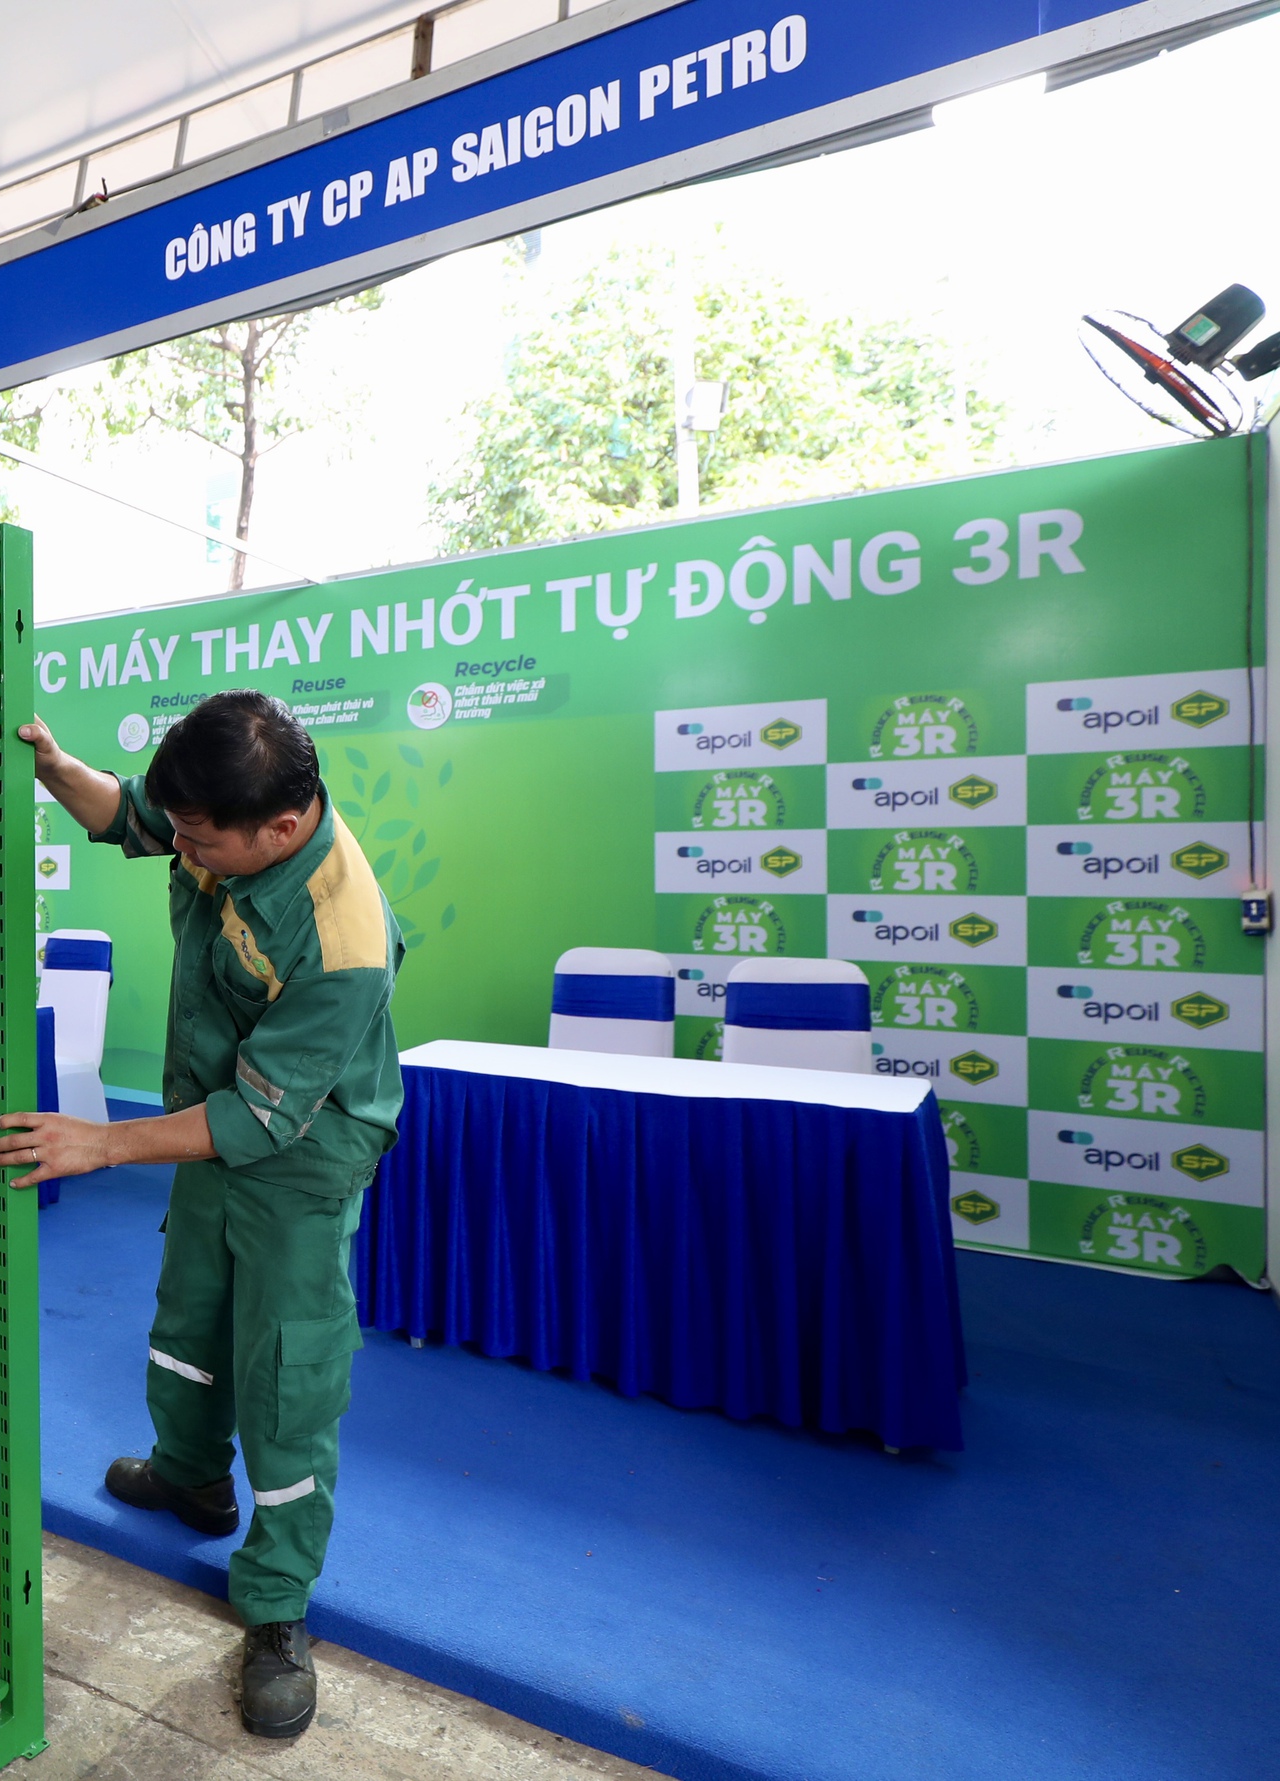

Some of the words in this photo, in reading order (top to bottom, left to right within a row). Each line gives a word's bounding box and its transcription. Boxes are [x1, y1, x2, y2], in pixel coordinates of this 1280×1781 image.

[165, 212, 256, 280] CÔNG
[267, 190, 311, 245] TY
[322, 170, 373, 227] CP
[383, 147, 438, 208] AP
[452, 79, 620, 183] SAIGON
[639, 14, 807, 121] PETRO
[80, 629, 180, 690] MÁY
[191, 613, 334, 675] THAY
[350, 579, 531, 658] NHỚT
[545, 562, 658, 640] TỰ
[668, 530, 920, 625] ĐỘNG
[952, 508, 1086, 586] 3R
[455, 654, 536, 677] Recycle
[292, 677, 346, 694] Reuse
[455, 682, 485, 696] Chấm
[506, 679, 530, 693] việc
[531, 677, 546, 689] xả
[150, 692, 207, 709] Reduce
[292, 703, 319, 715] Không
[320, 701, 342, 713] phát
[343, 698, 361, 710] thải
[454, 695, 480, 708] nhớt
[481, 693, 502, 706] thải
[503, 694, 516, 704] ra
[516, 689, 539, 702] môi
[315, 714, 335, 725] chai
[336, 711, 358, 723] nhớt
[455, 706, 492, 719] trường
[898, 708, 952, 726] MÁY
[1083, 706, 1158, 733] apoil
[1180, 702, 1219, 717] SP
[696, 731, 752, 754] apoil
[767, 728, 796, 741] SP
[892, 726, 957, 756] 3R
[1110, 767, 1174, 786] MÁY
[717, 783, 762, 798] MÁY
[874, 788, 938, 812] apoil
[957, 786, 988, 798] SP
[712, 801, 767, 827] 3R
[1105, 787, 1181, 819] 3R
[898, 845, 952, 860] MÁY
[41, 863, 55, 872] SP
[696, 857, 752, 878] apoil
[767, 855, 796, 868] SP
[892, 862, 957, 891] 3R
[1083, 854, 1158, 879] apoil
[1180, 853, 1219, 867] SP
[717, 909, 762, 924] MÁY
[1110, 916, 1174, 933] MÁY
[712, 925, 768, 952] 3R
[875, 923, 939, 946] apoil
[957, 924, 988, 936] SP
[1105, 934, 1181, 967] 3R
[898, 980, 952, 996] MÁY
[894, 996, 958, 1028] 3R
[1083, 1001, 1158, 1024] apoil
[1180, 1003, 1219, 1017] SP
[876, 1057, 939, 1076] apoil
[957, 1062, 988, 1075] SP
[1111, 1062, 1174, 1081] MÁY
[1105, 1080, 1181, 1115] 3R
[1084, 1148, 1160, 1171] apoil
[1182, 1154, 1219, 1168] SP
[959, 1200, 992, 1214] SP
[1112, 1211, 1174, 1231] MÁY
[1106, 1226, 1182, 1266] 3R
